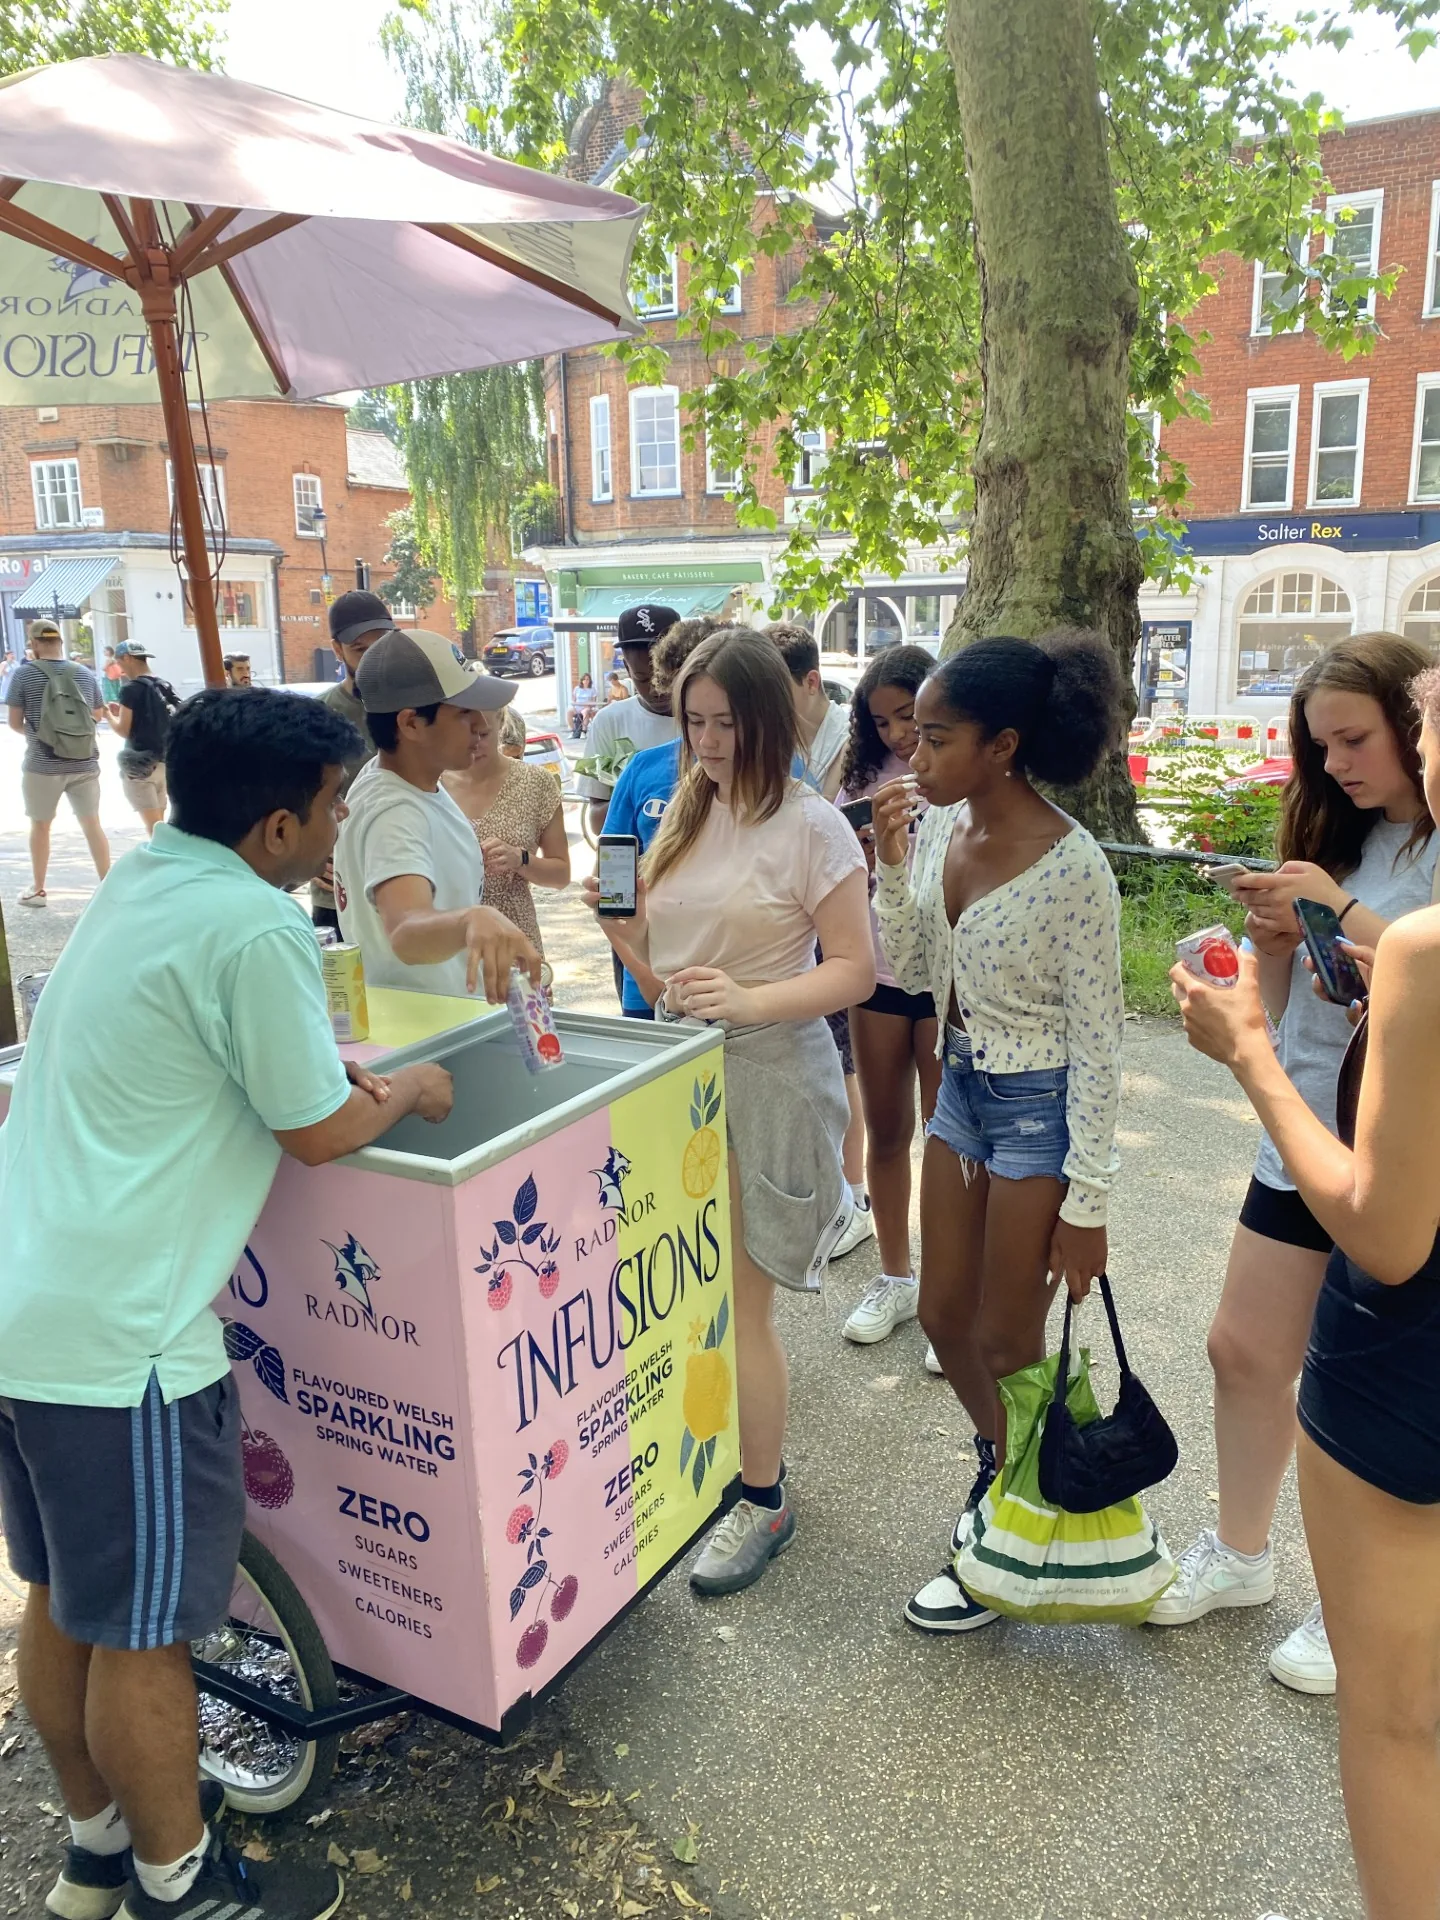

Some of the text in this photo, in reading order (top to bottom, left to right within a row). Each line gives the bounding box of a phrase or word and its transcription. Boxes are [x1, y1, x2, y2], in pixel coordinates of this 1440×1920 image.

[1257, 522, 1342, 541] Salter Rex
[0, 555, 49, 578] Royal
[574, 1191, 657, 1262] RADNOR
[833, 1215, 846, 1230] UGG
[811, 1255, 822, 1271] UGG
[304, 1293, 421, 1347] RADNOR
[497, 1198, 720, 1433] INFUSIONS
[292, 1368, 454, 1431] FLAVOURED WELSH
[577, 1340, 673, 1427] FLAVOURED WELSH
[579, 1357, 674, 1450] SPARKLING
[297, 1390, 456, 1461] SPARKLING
[592, 1388, 664, 1459] SPRING WATER
[316, 1425, 439, 1478] SPRING WATER
[604, 1441, 659, 1508] ZERO
[336, 1485, 430, 1543] ZERO
[603, 1492, 665, 1560] SWEETENERS
[614, 1479, 653, 1522] SUGARS
[354, 1535, 418, 1570] SUGARS
[613, 1524, 659, 1576] CALORIES
[337, 1559, 443, 1612] SWEETENERS
[355, 1596, 432, 1639] CALORIES
